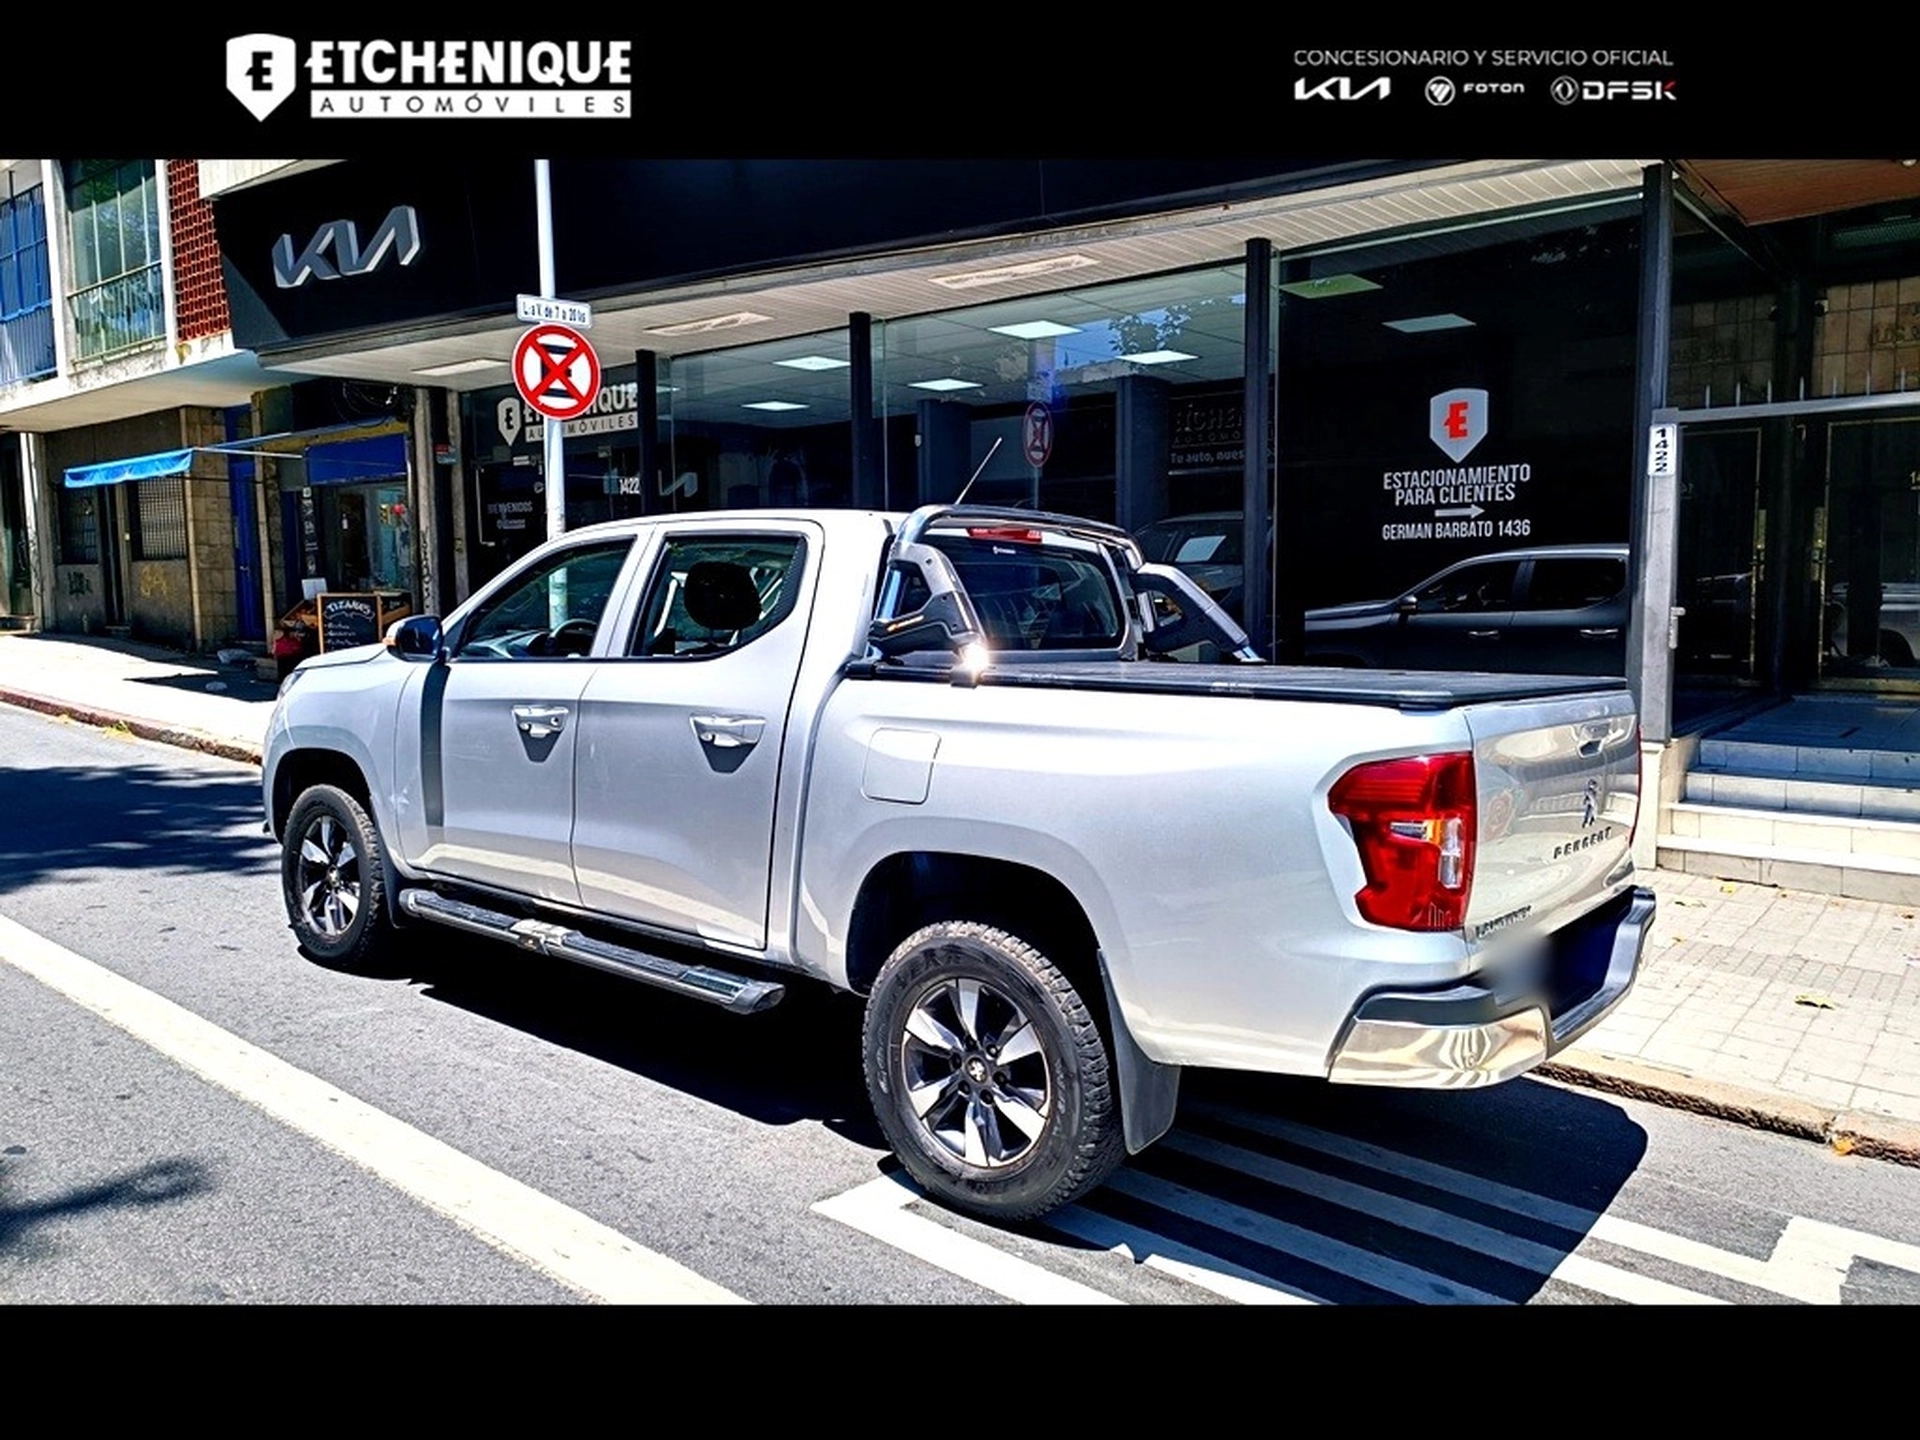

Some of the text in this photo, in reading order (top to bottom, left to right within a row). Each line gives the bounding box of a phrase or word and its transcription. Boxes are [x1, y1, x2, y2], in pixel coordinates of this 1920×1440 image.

[271, 205, 421, 289] KIA
[528, 414, 635, 440] AUMÓVILES
[1216, 449, 1245, 461] nues
[1654, 428, 1669, 473] 1422
[1382, 463, 1531, 490] ESTACIONAMIENTO
[1394, 483, 1516, 507] PARA CLIENTES
[1382, 519, 1531, 540] GERMAN BARBATO 1436
